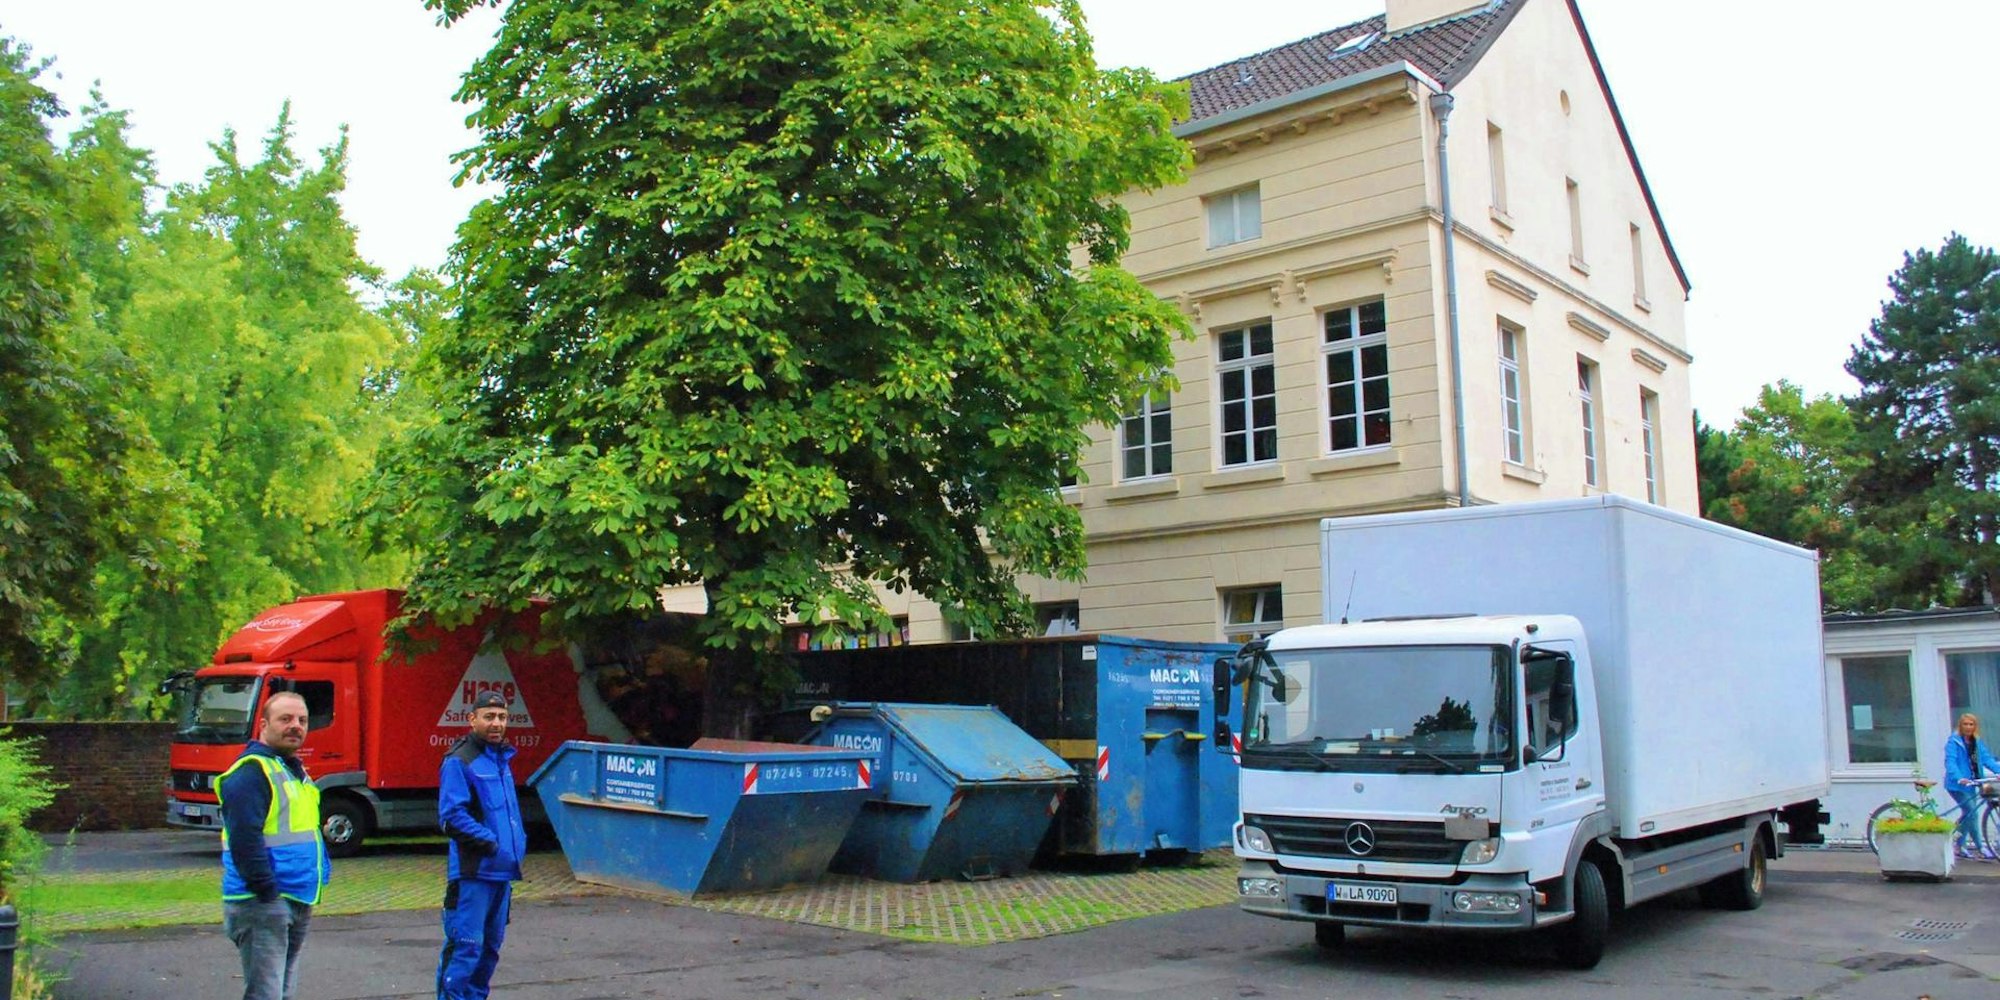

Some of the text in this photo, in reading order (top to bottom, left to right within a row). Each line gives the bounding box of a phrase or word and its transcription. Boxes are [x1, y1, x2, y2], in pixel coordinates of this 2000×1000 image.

[515, 735, 540, 746] 1937
[1349, 887, 1364, 900] LA
[1366, 888, 1395, 902] 9090
